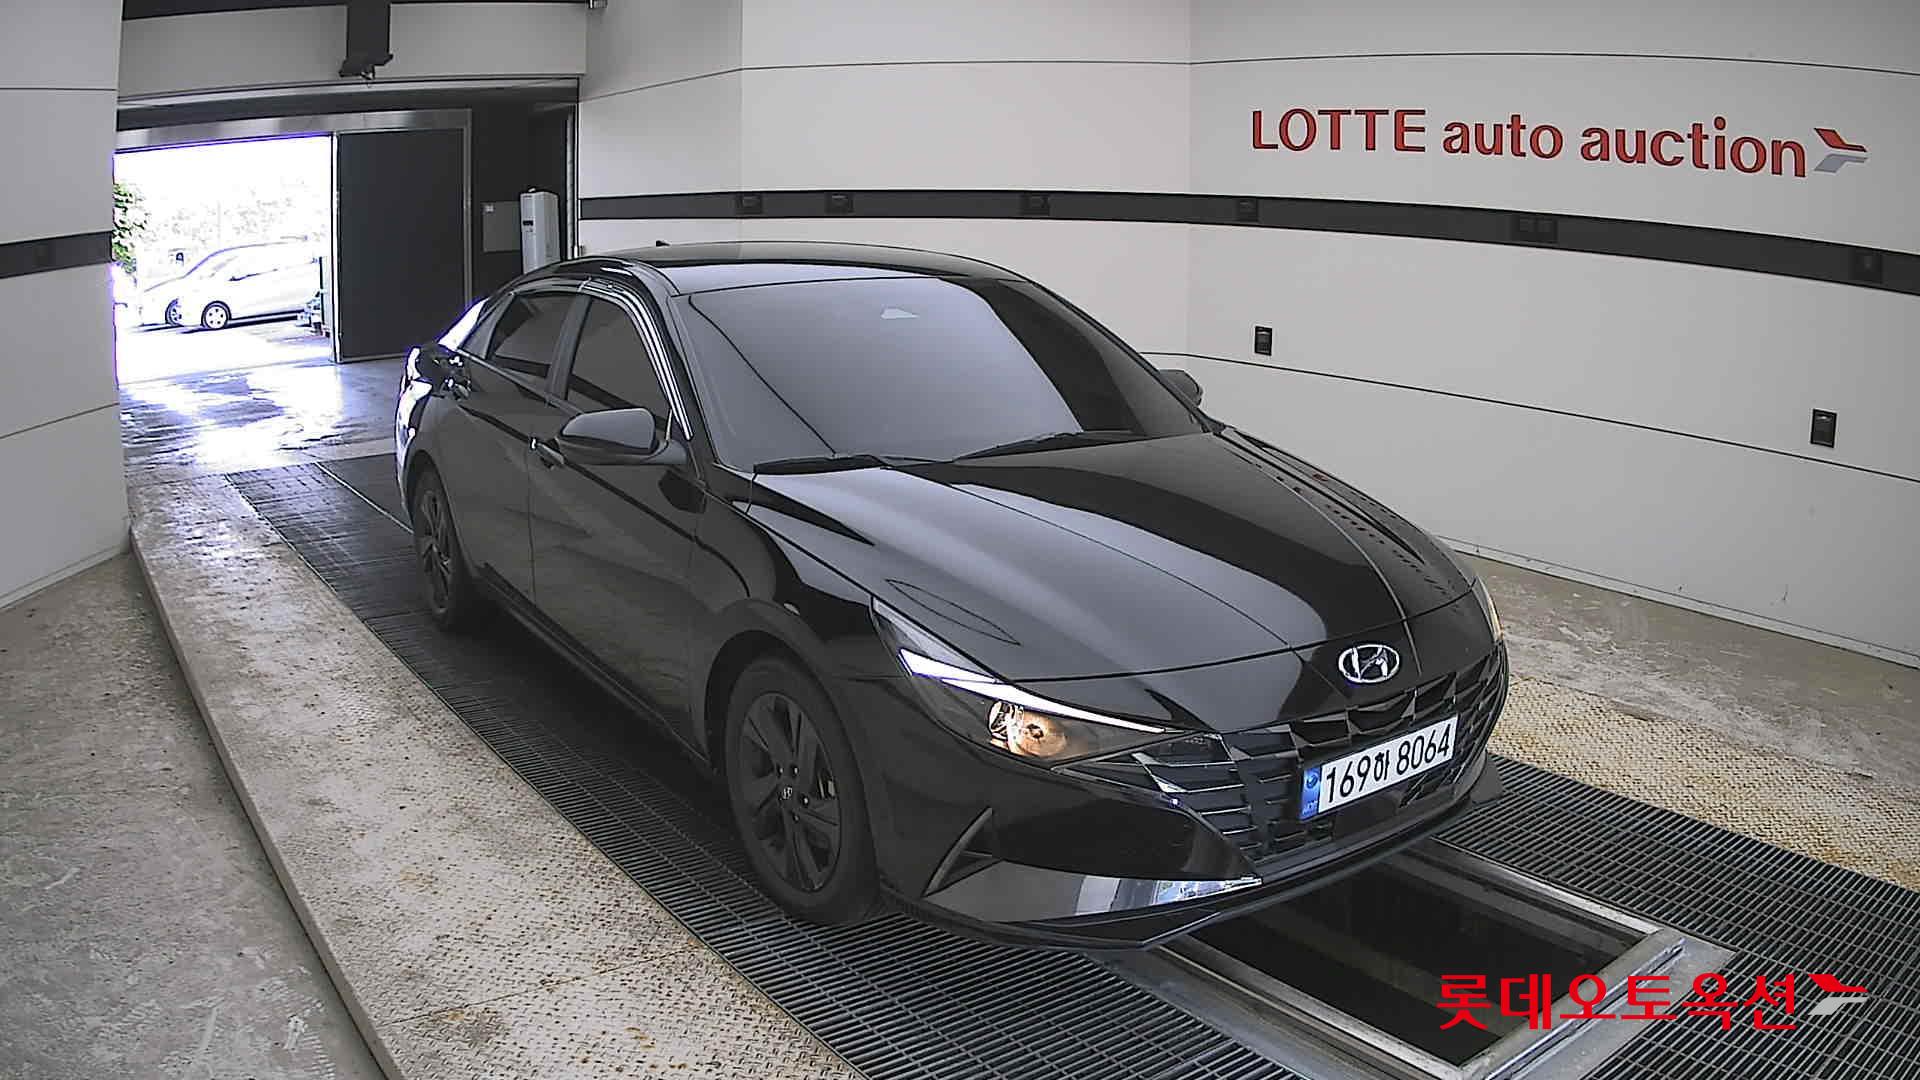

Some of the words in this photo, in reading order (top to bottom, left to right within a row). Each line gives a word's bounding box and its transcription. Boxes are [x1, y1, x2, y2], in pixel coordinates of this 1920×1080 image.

[1252, 108, 1427, 153] LOTTE
[1442, 113, 1564, 160] auto
[1579, 116, 1808, 179] auction
[1396, 723, 1452, 776] 8064
